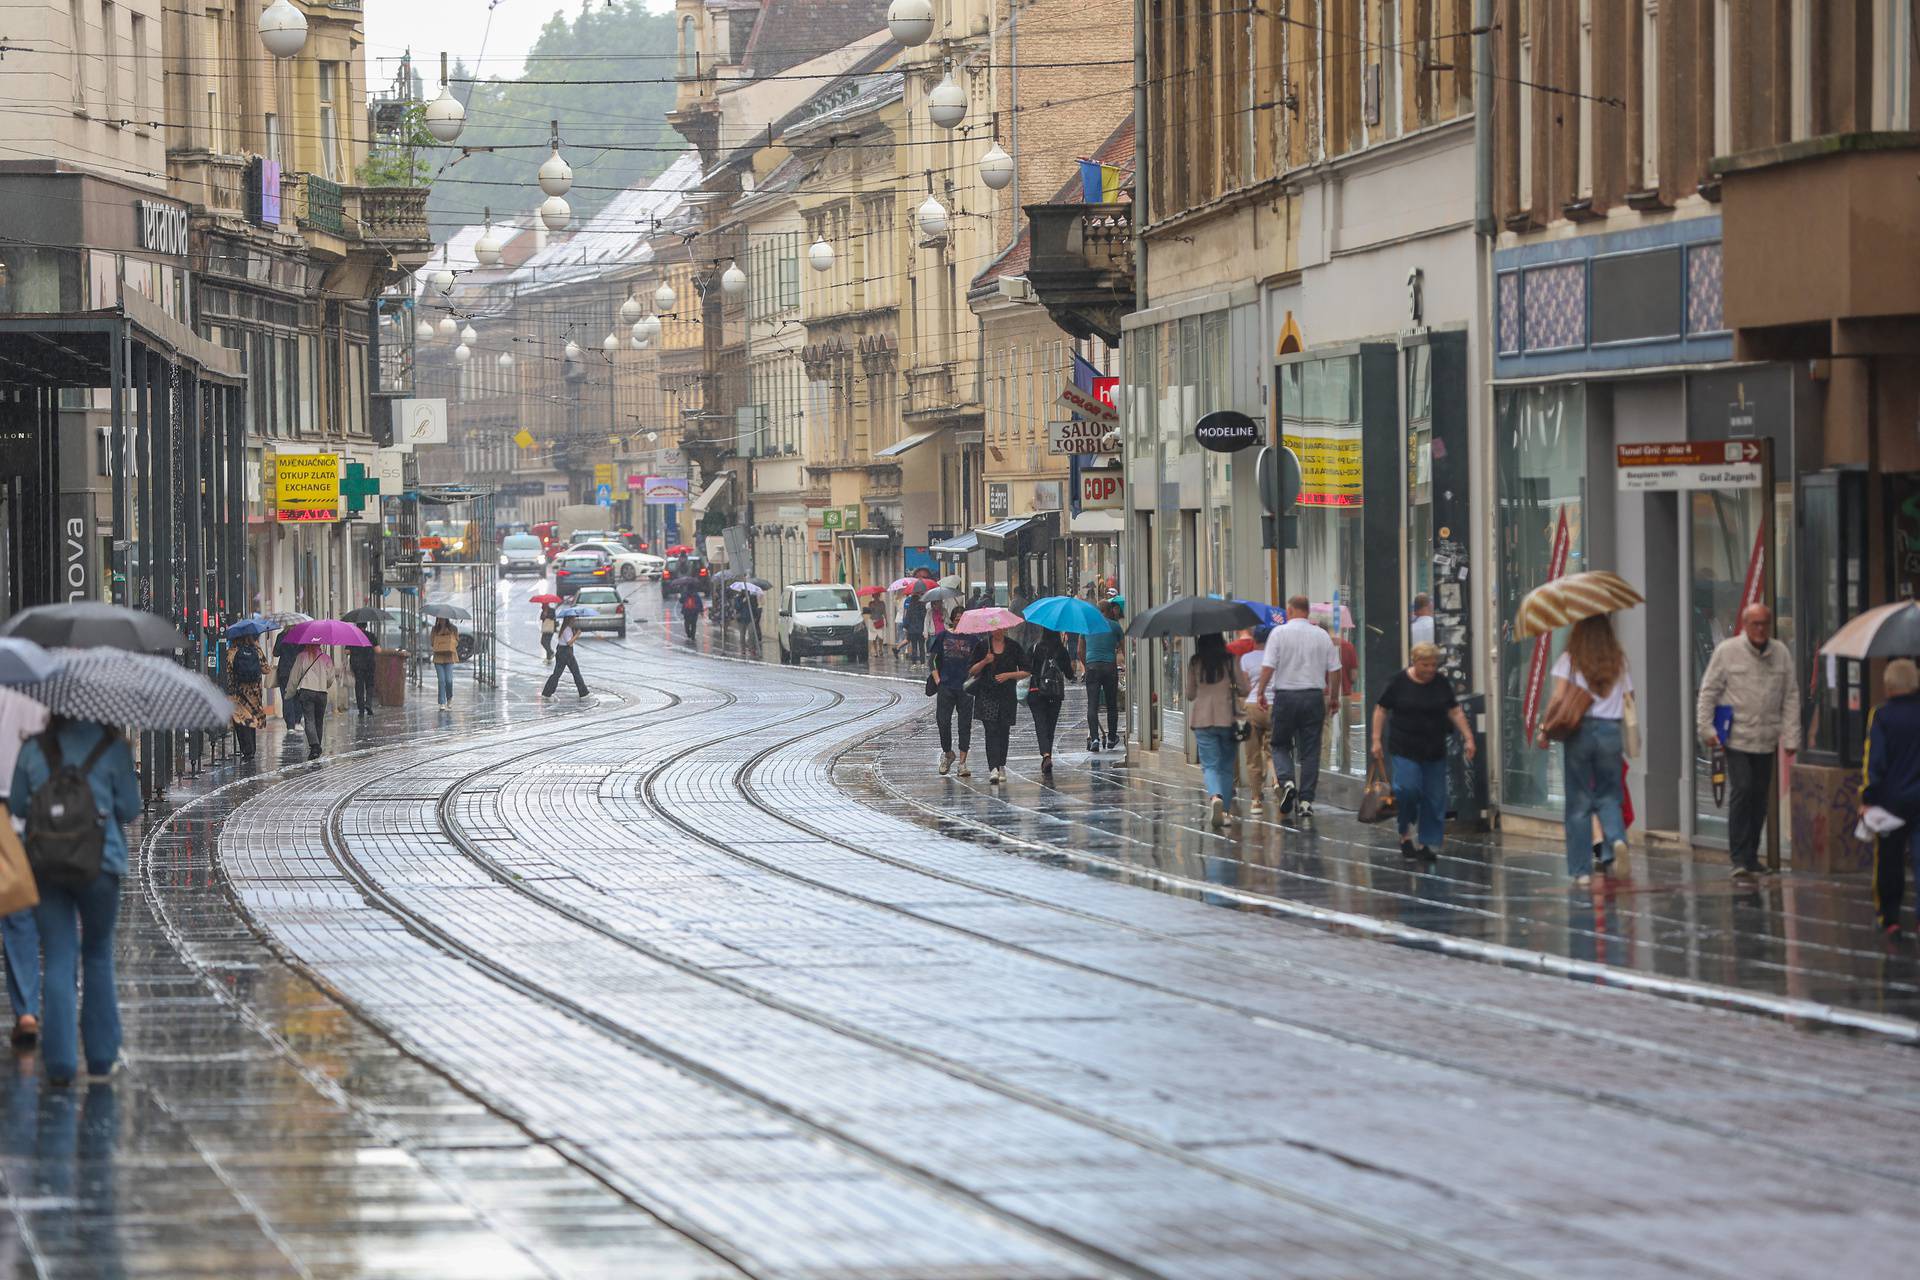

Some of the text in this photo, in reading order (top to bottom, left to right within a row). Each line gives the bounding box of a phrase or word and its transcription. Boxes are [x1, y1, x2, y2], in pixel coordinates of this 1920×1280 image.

[1062, 421, 1113, 439] SALON
[1199, 427, 1254, 437] MODELINE
[0, 432, 33, 442] LONE
[279, 457, 336, 468] MJENJAČNICA
[280, 471, 336, 480] OTKUP ZLATA
[1699, 472, 1757, 483] Grad Zagreb
[285, 483, 331, 492] EXCHANGE
